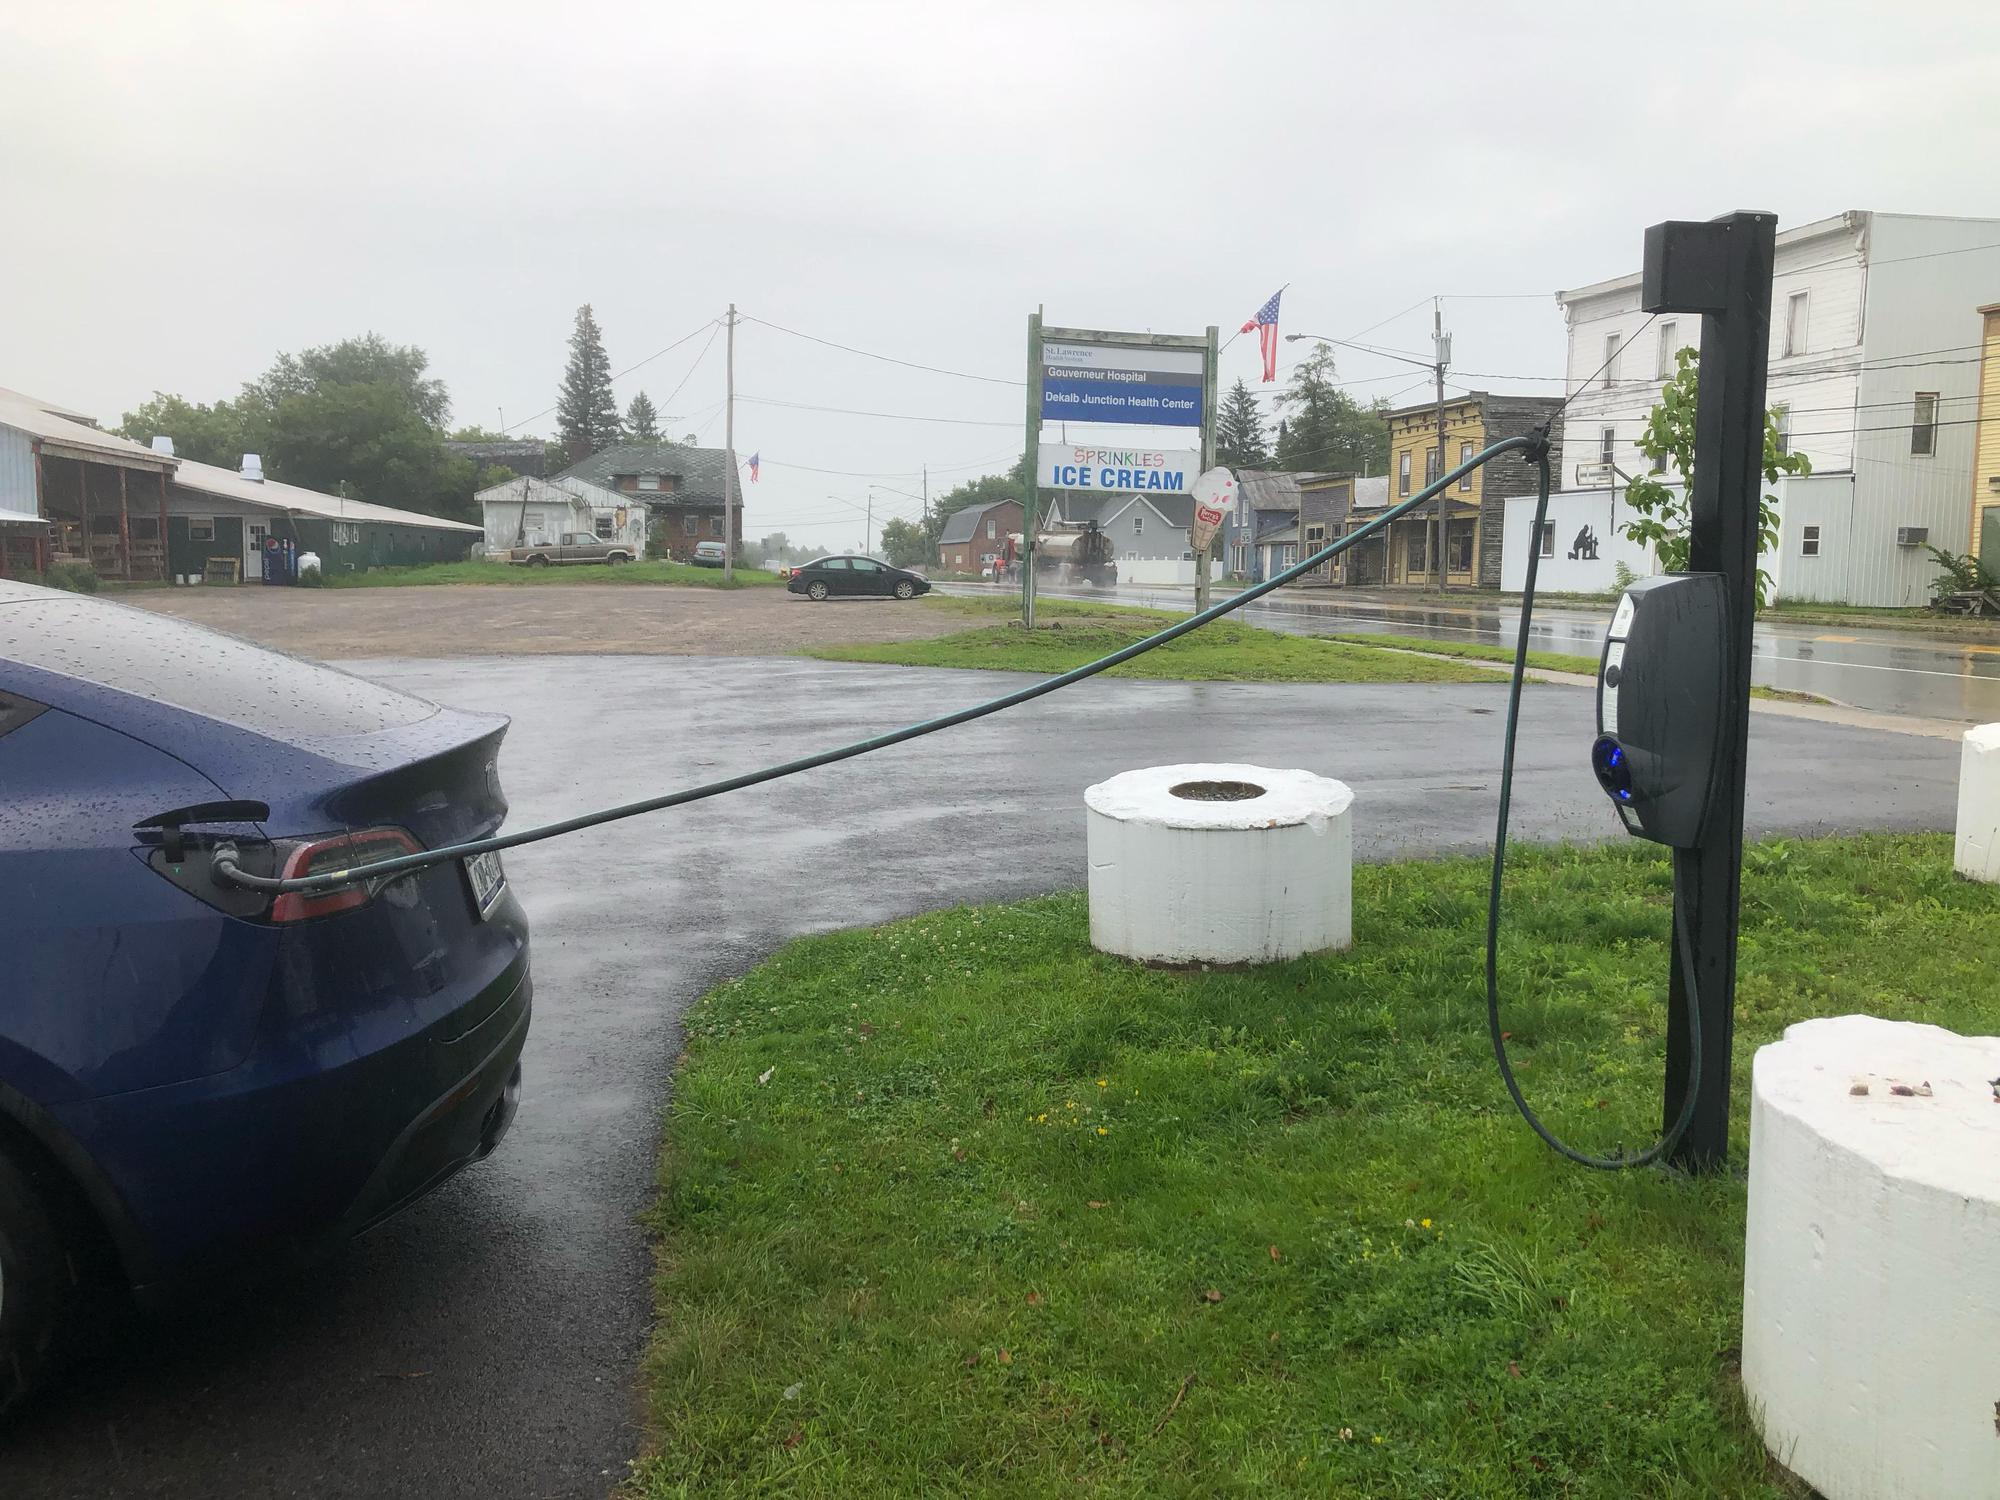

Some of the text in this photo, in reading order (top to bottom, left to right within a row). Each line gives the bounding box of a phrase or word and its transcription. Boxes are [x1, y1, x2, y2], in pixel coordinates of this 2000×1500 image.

[1056, 347, 1093, 358] Lawrence
[1048, 366, 1147, 383] Gouverneur Hospital
[1045, 391, 1195, 409] Dekalb Junction Health Center
[1074, 449, 1164, 467] SPRINKLES
[1054, 465, 1183, 490] ICE CREAM
